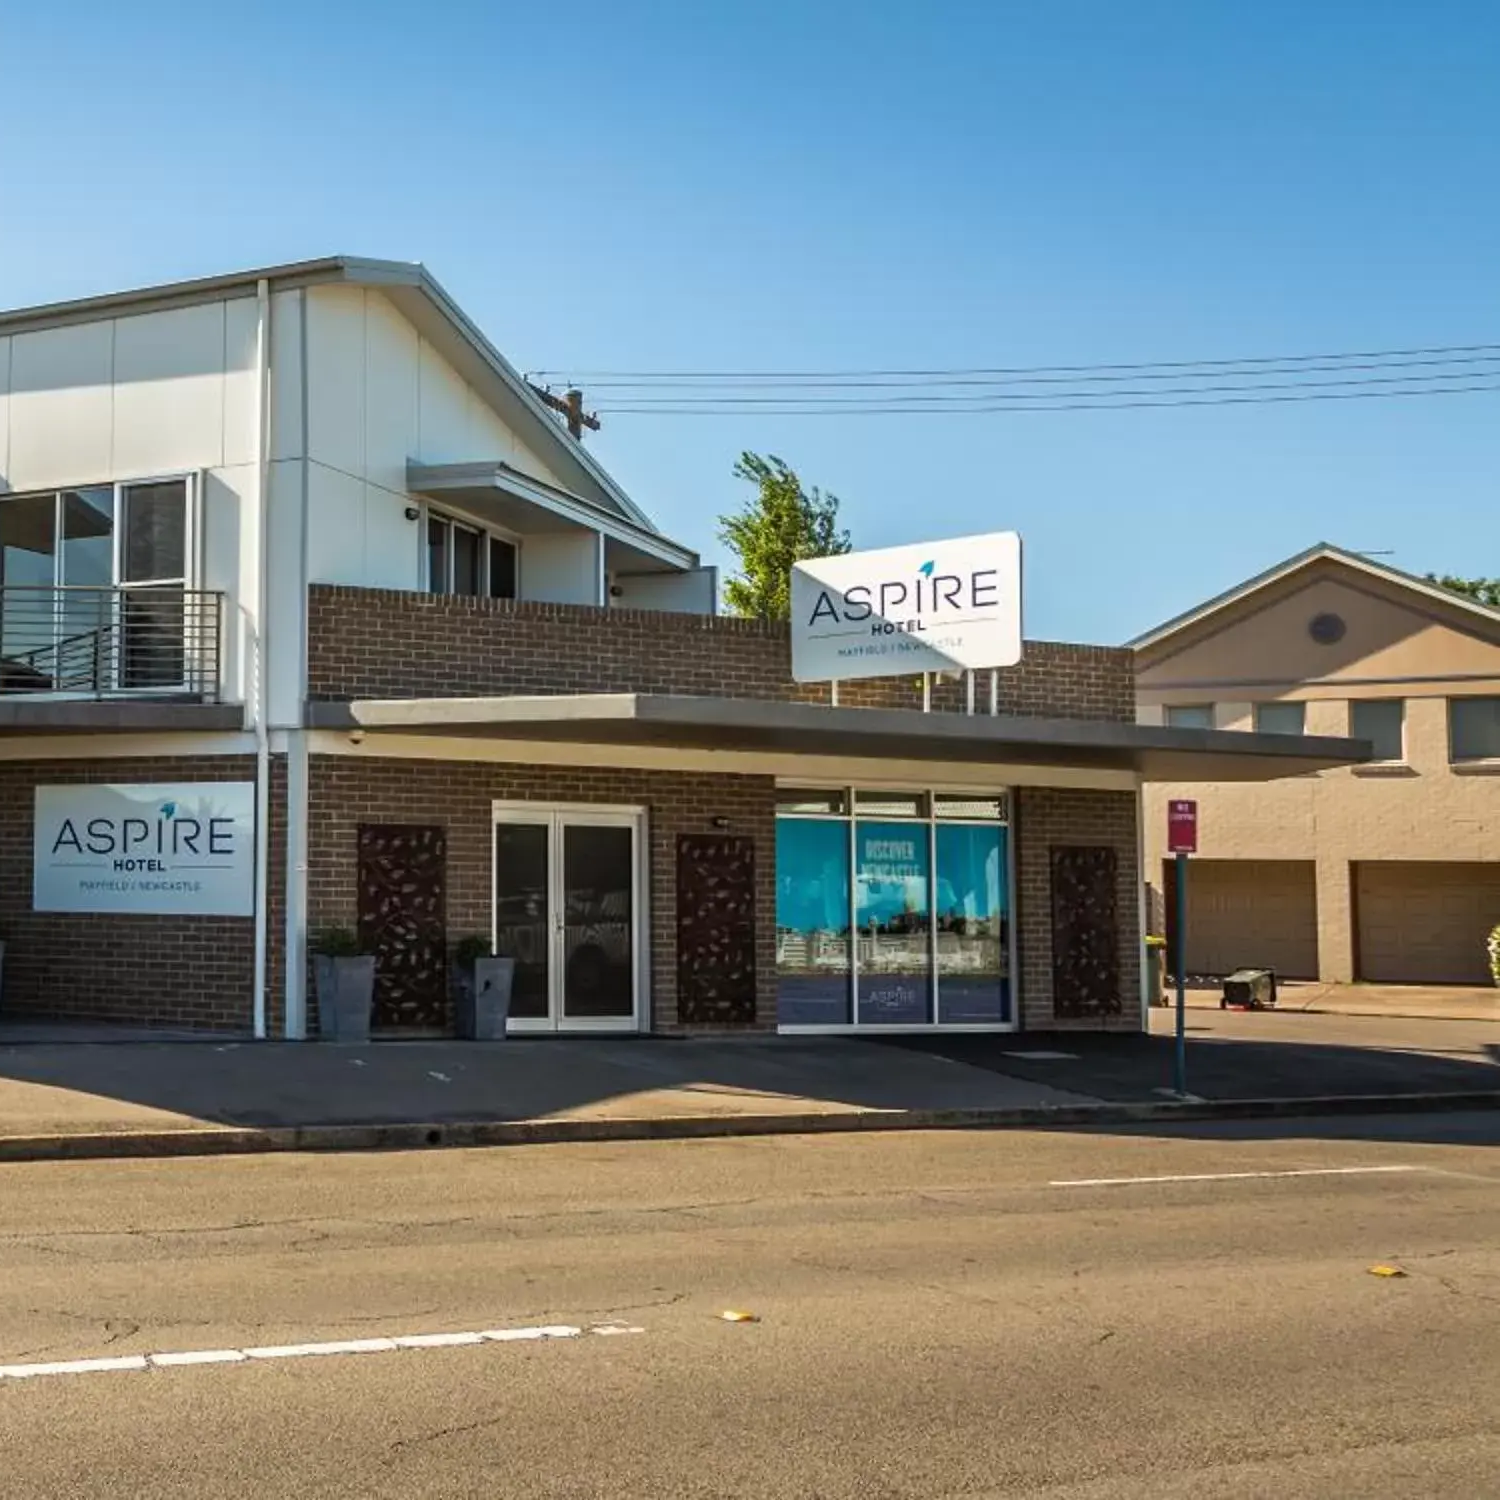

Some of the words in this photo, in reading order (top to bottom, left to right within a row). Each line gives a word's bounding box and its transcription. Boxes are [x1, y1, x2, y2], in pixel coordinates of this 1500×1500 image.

[808, 569, 999, 626] ASPIRE
[871, 619, 927, 636] HOTEL
[52, 818, 235, 855] ASPIRE
[865, 839, 915, 860] DISCOVER
[113, 859, 167, 872] HOTEL
[79, 880, 127, 891] MAYFIELD
[139, 880, 201, 891] NEWCASTLE
